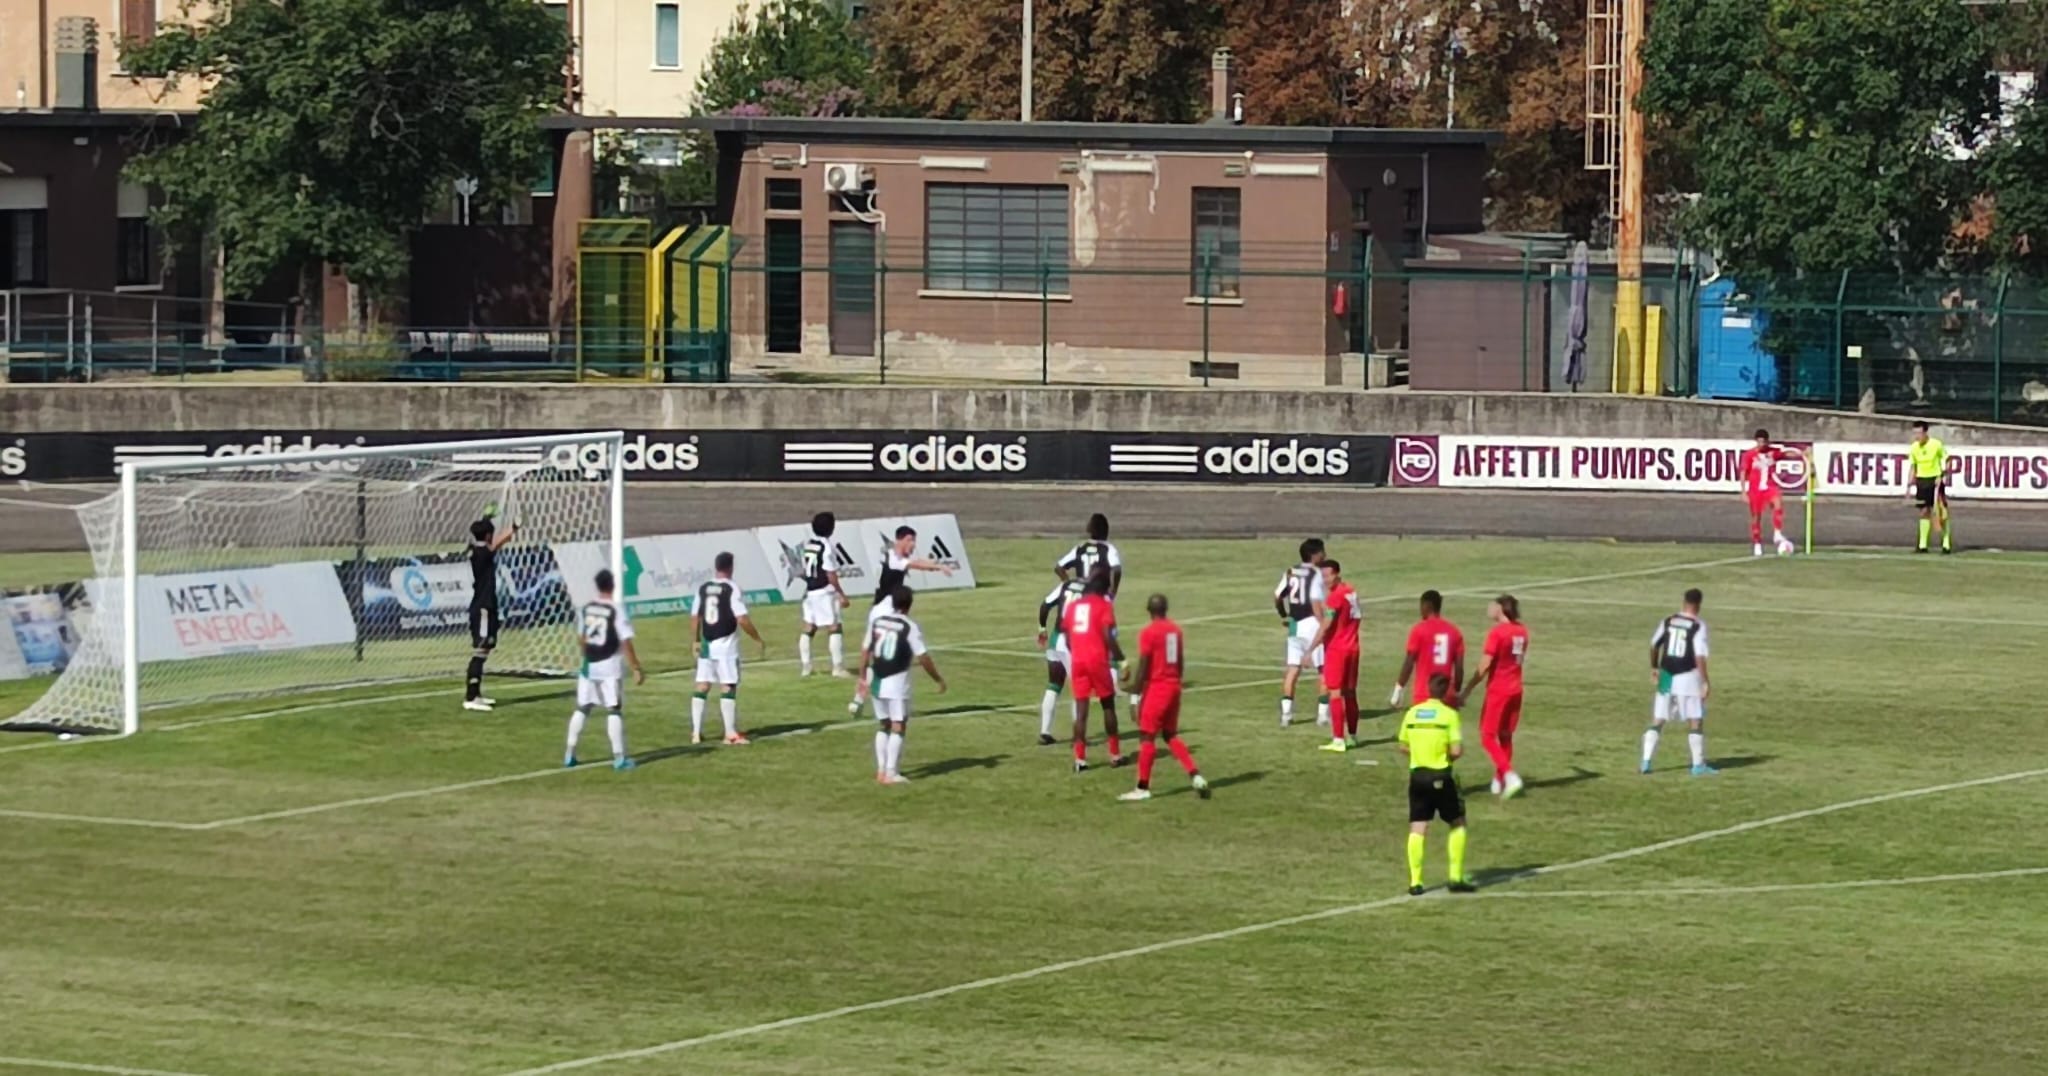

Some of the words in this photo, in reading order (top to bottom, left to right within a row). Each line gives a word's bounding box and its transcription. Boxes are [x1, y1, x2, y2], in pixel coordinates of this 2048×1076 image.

[880, 435, 1027, 471] adidas
[1204, 439, 1349, 475] adidas
[1453, 445, 1560, 477] AFFETTI
[1827, 451, 1909, 486] AFFET
[1946, 455, 2048, 489] PUMPS
[165, 584, 243, 614] META
[1289, 576, 1306, 605] 21
[704, 596, 719, 625] 6
[174, 612, 294, 647] ENERGIA
[875, 627, 898, 660] 70
[1667, 627, 1688, 658] 16
